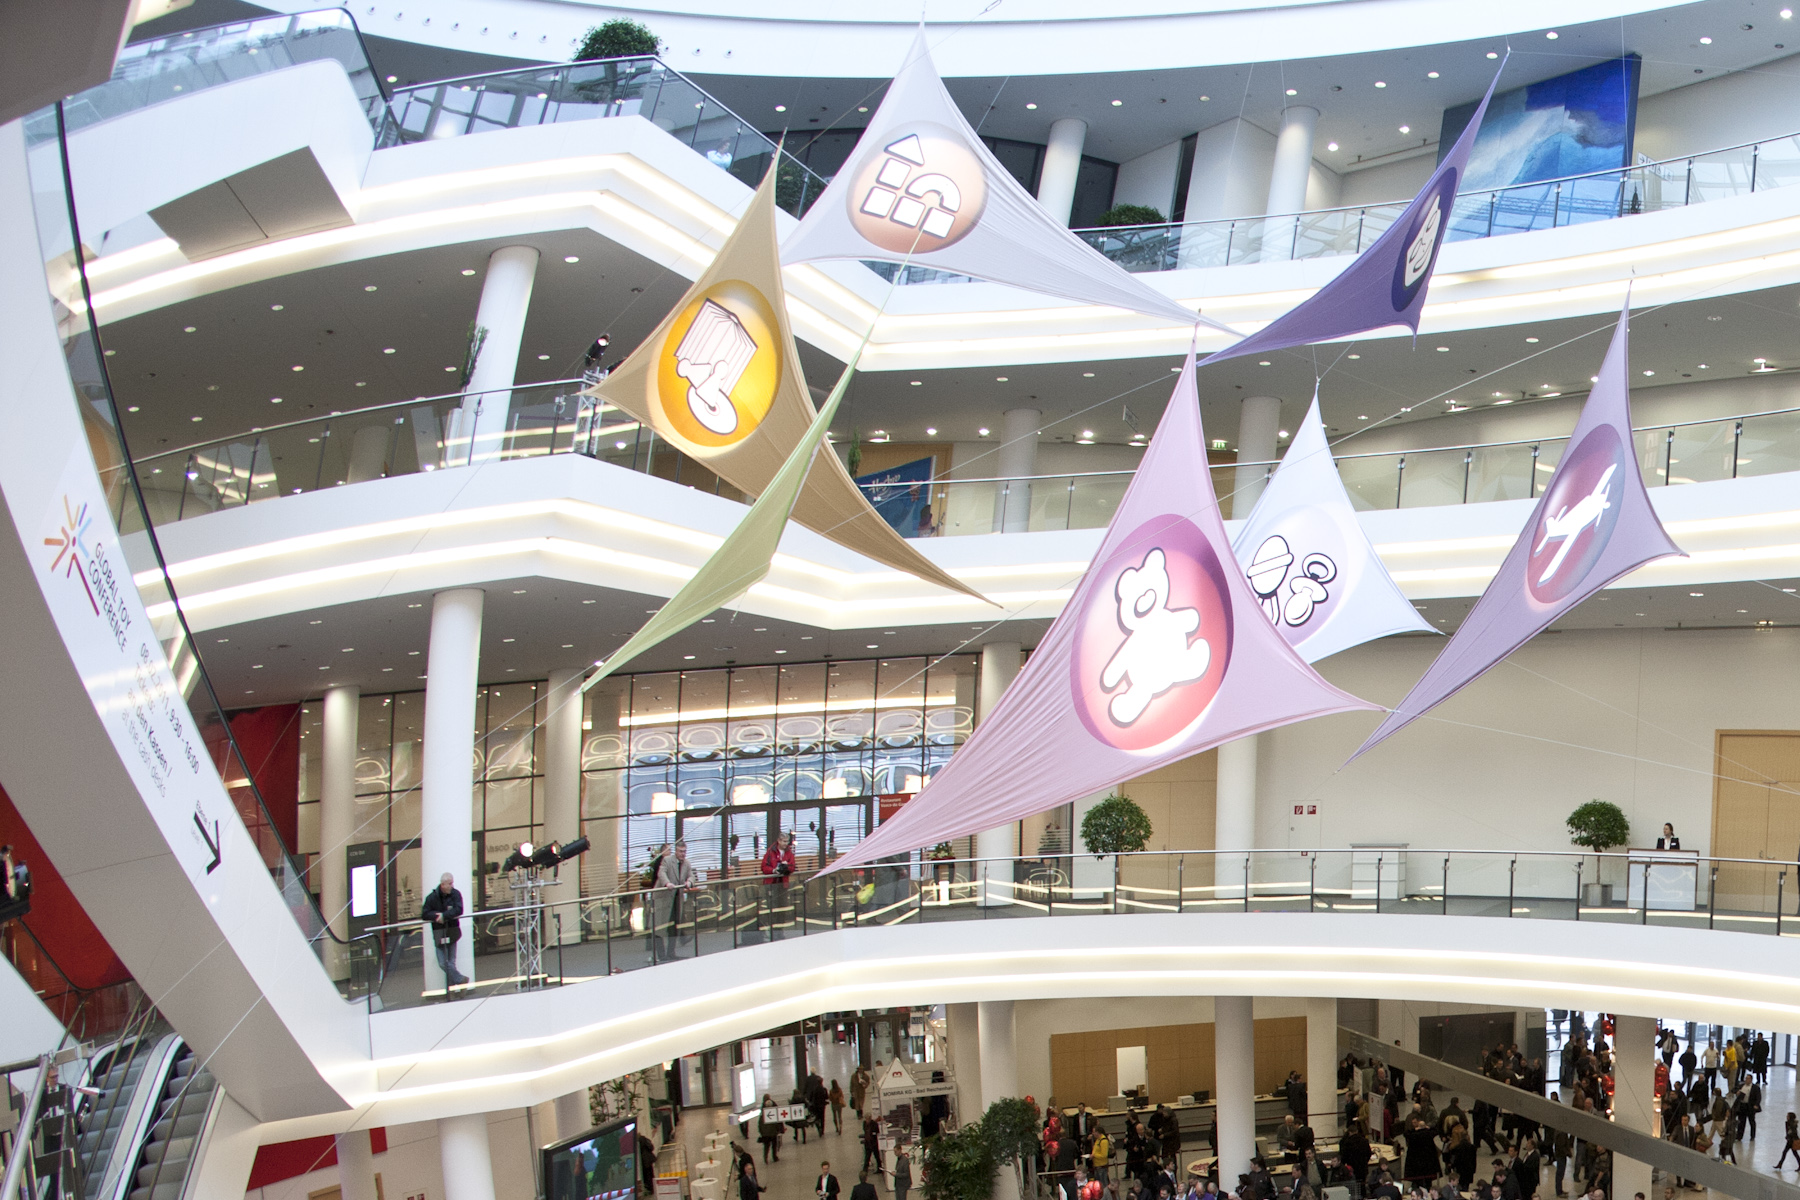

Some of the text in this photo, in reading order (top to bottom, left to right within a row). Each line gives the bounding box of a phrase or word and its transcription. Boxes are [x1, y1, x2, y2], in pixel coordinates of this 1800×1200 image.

[88, 560, 127, 653] CONFERENCE
[95, 542, 131, 630] GLOBAL TOY
[148, 726, 168, 772] Kassen
